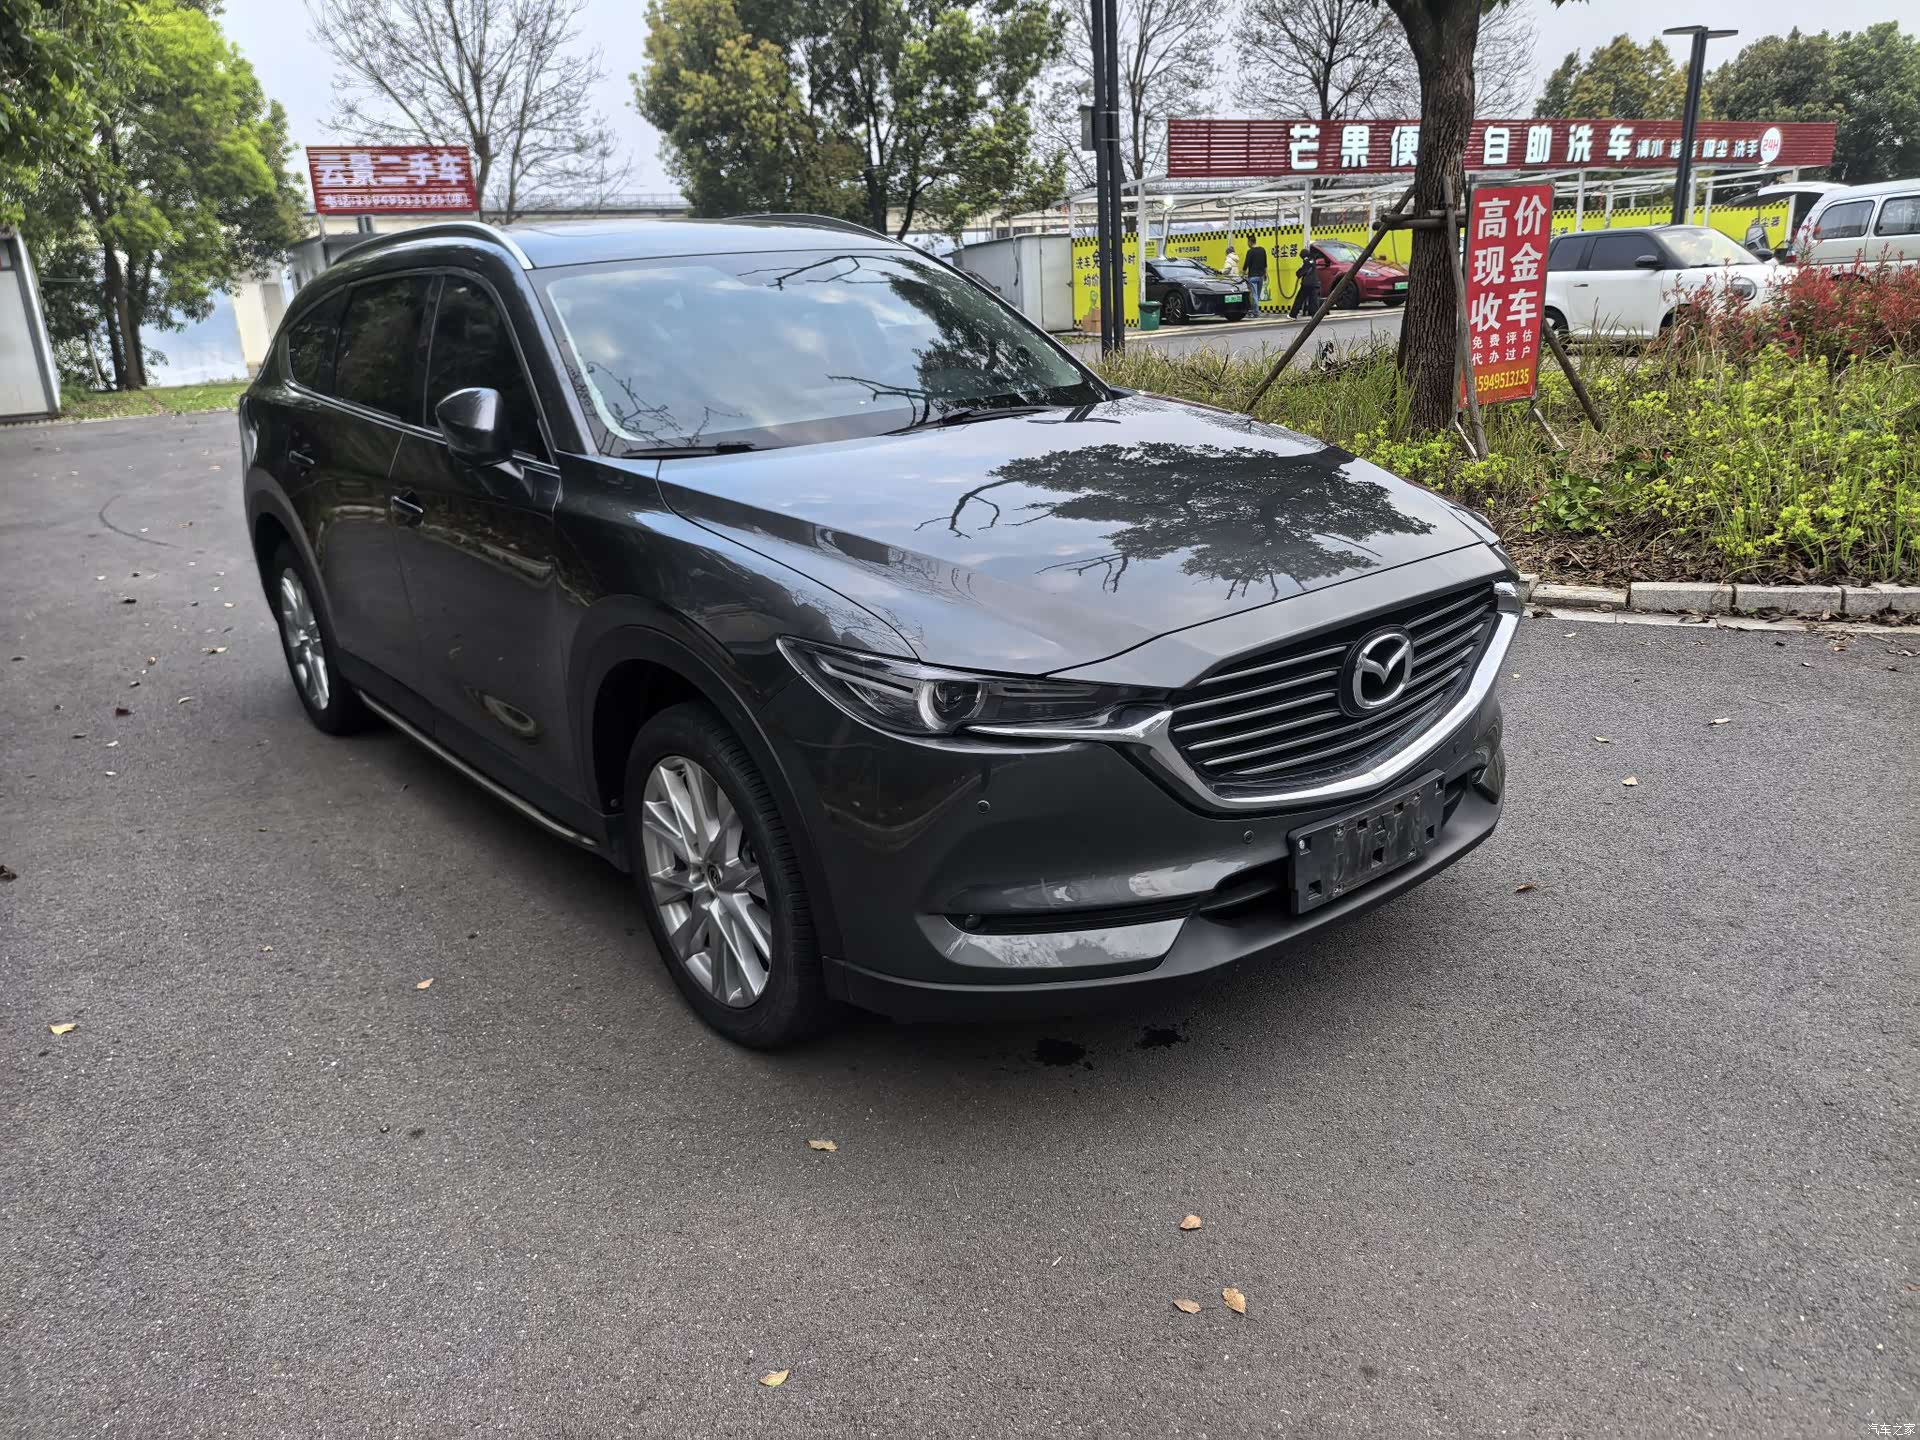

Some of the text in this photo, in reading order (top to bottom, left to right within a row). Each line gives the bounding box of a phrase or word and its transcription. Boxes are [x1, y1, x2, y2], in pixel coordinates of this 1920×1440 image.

[1289, 123, 1634, 170] 芒果便自助洗车
[1732, 139, 1759, 158] 洗手
[1762, 139, 1779, 152] 24H
[318, 153, 466, 187] 云景二手车
[1477, 194, 1547, 240] 高价
[1472, 242, 1543, 287] 现金
[1470, 288, 1538, 333] 收车
[1471, 329, 1532, 351] 免费评估
[1471, 346, 1531, 366] 代办过户
